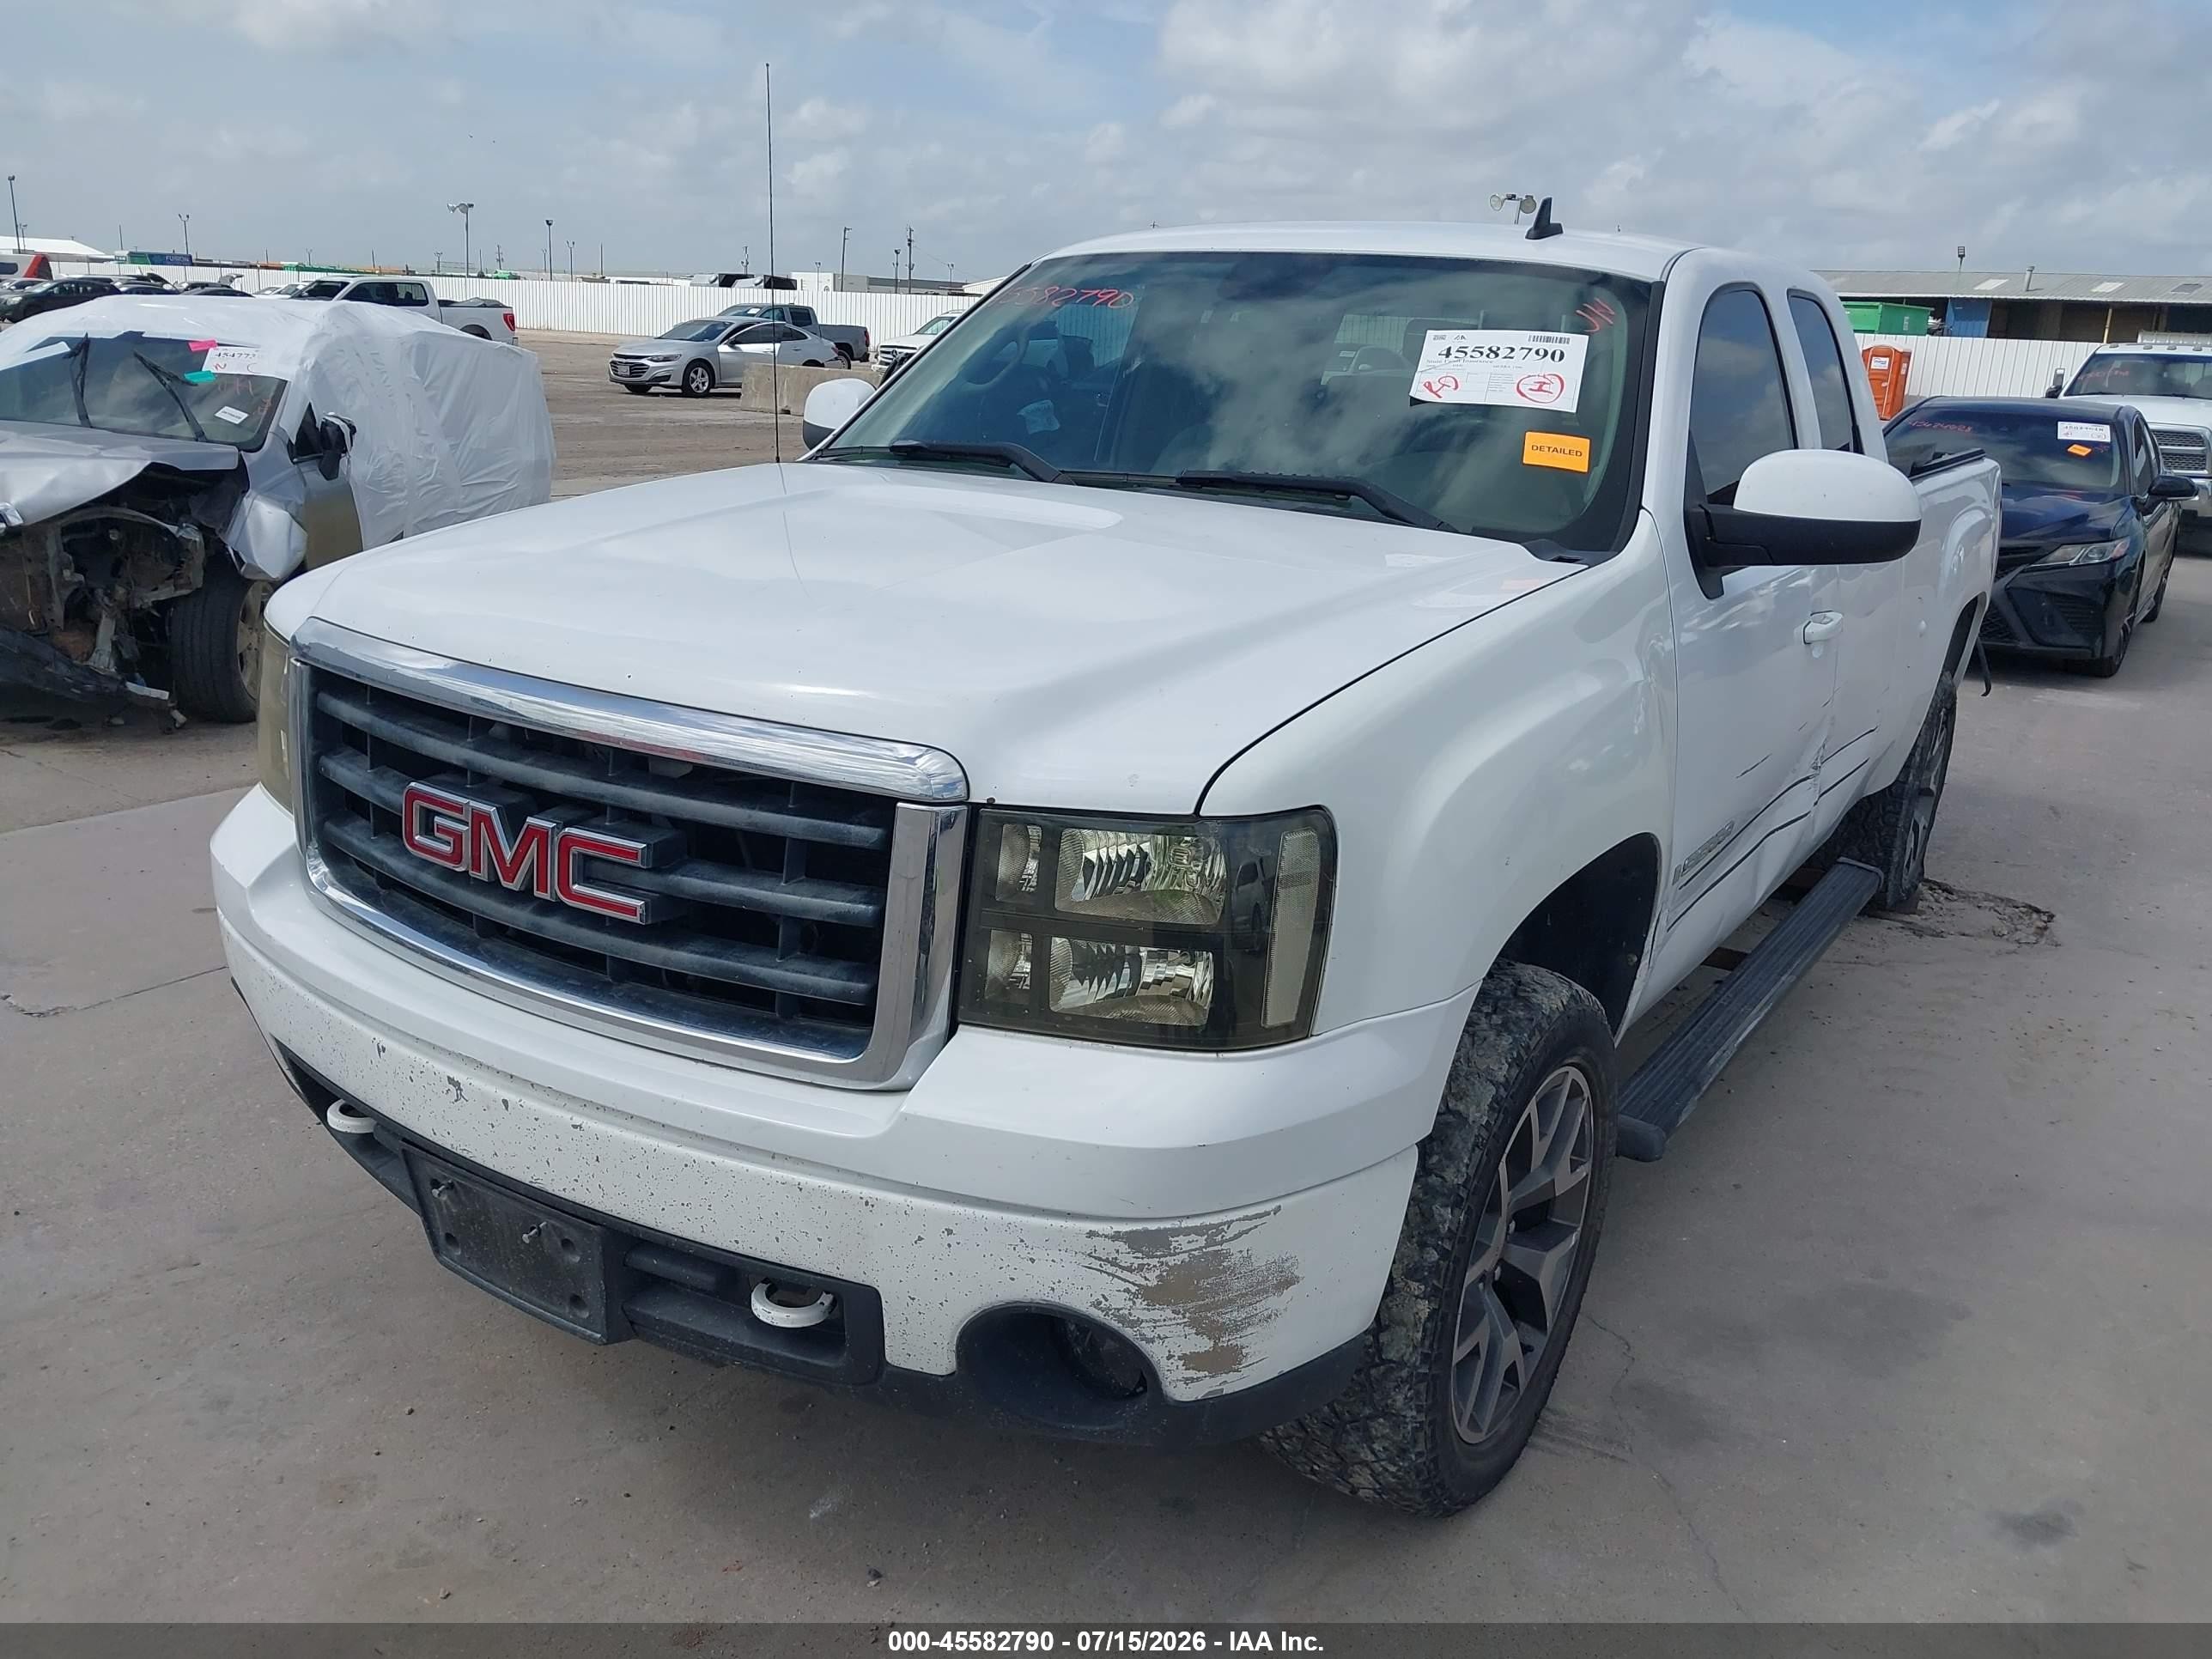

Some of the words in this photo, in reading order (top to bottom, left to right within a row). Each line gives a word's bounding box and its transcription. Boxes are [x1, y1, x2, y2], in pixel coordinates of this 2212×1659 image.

[1437, 345, 1565, 362] 45582790
[1531, 444, 1583, 458] DETAILED
[402, 781, 648, 925] GMC
